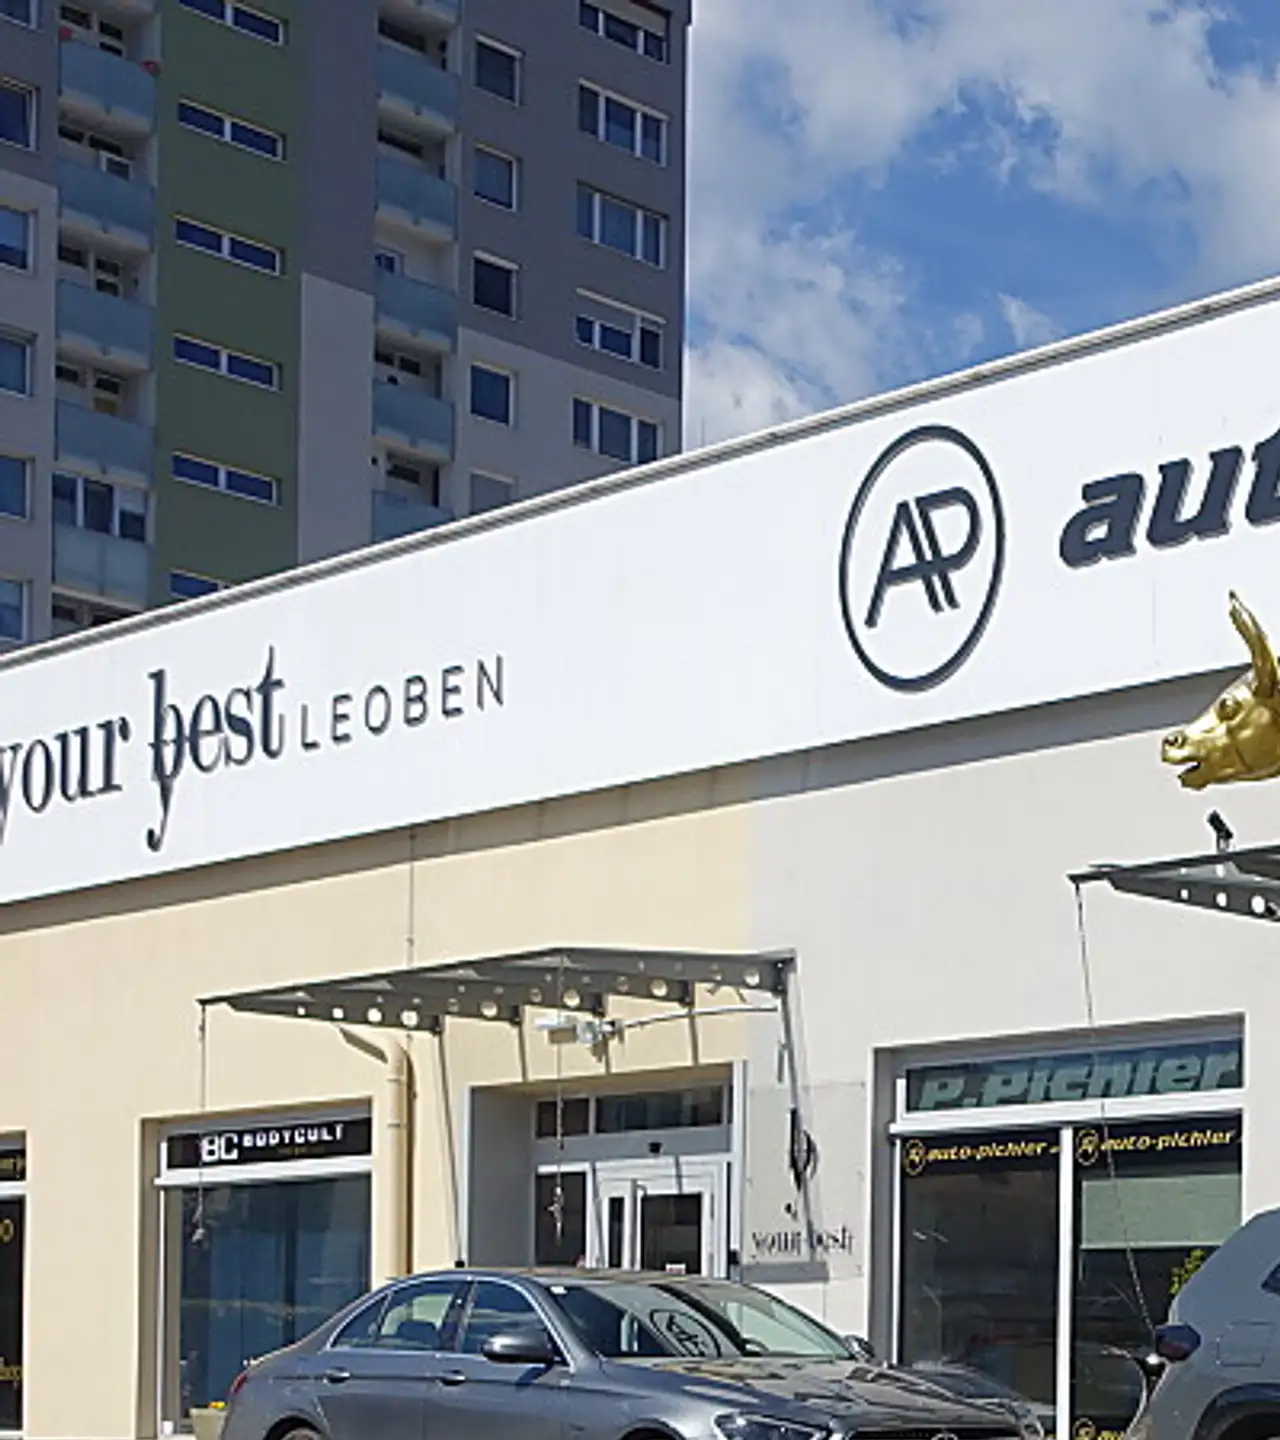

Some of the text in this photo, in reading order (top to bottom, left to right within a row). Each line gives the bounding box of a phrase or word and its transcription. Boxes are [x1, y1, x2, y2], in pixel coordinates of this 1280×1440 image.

[147, 645, 286, 852] best
[300, 655, 505, 752] LEOBEN
[242, 1123, 344, 1148] BODYCULT
